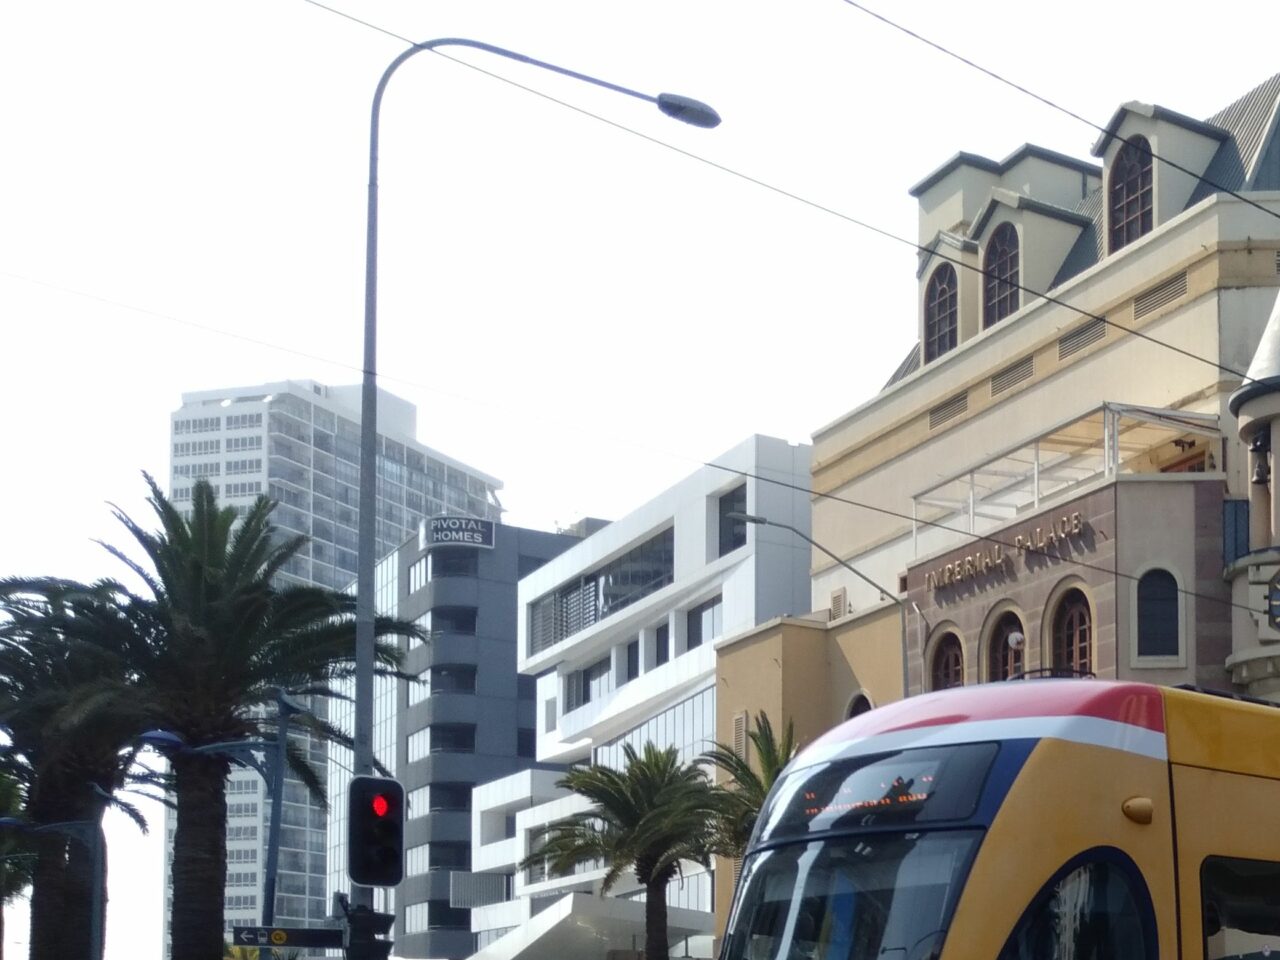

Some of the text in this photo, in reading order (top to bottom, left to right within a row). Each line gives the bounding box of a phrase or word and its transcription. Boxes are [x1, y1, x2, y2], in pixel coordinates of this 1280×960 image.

[431, 519, 486, 532] PIVOTAL
[433, 531, 483, 543] HOMES
[1014, 512, 1083, 557] PALACE
